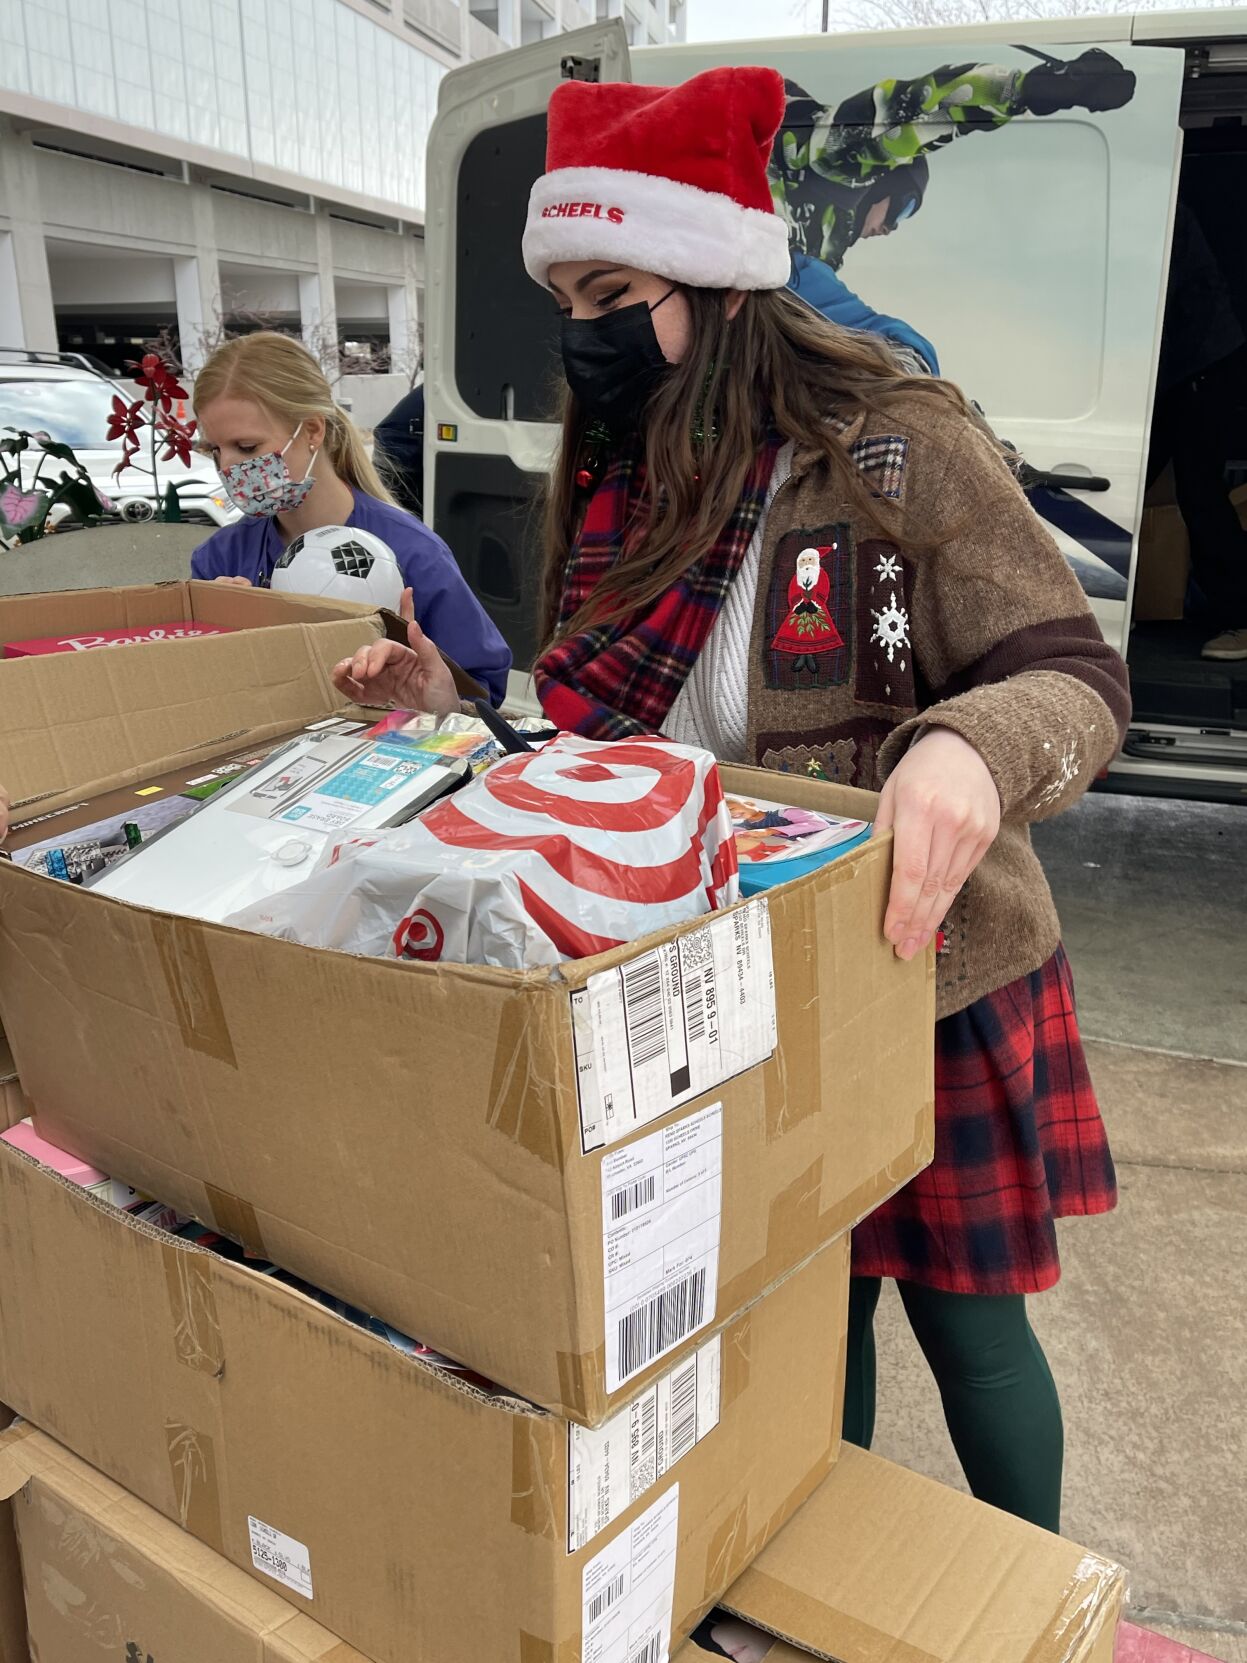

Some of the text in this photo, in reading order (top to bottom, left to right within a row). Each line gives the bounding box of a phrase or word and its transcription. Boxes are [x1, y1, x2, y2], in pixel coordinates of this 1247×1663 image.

[732, 910, 740, 942] SPARKS
[736, 944, 741, 956] NV
[669, 954, 679, 998] GROUND
[703, 965, 714, 986] NV
[574, 997, 583, 1005] TO
[705, 985, 715, 1010] 895
[579, 1063, 592, 1073] SKU
[584, 1124, 596, 1134] PO#
[631, 1447, 639, 1466] NV
